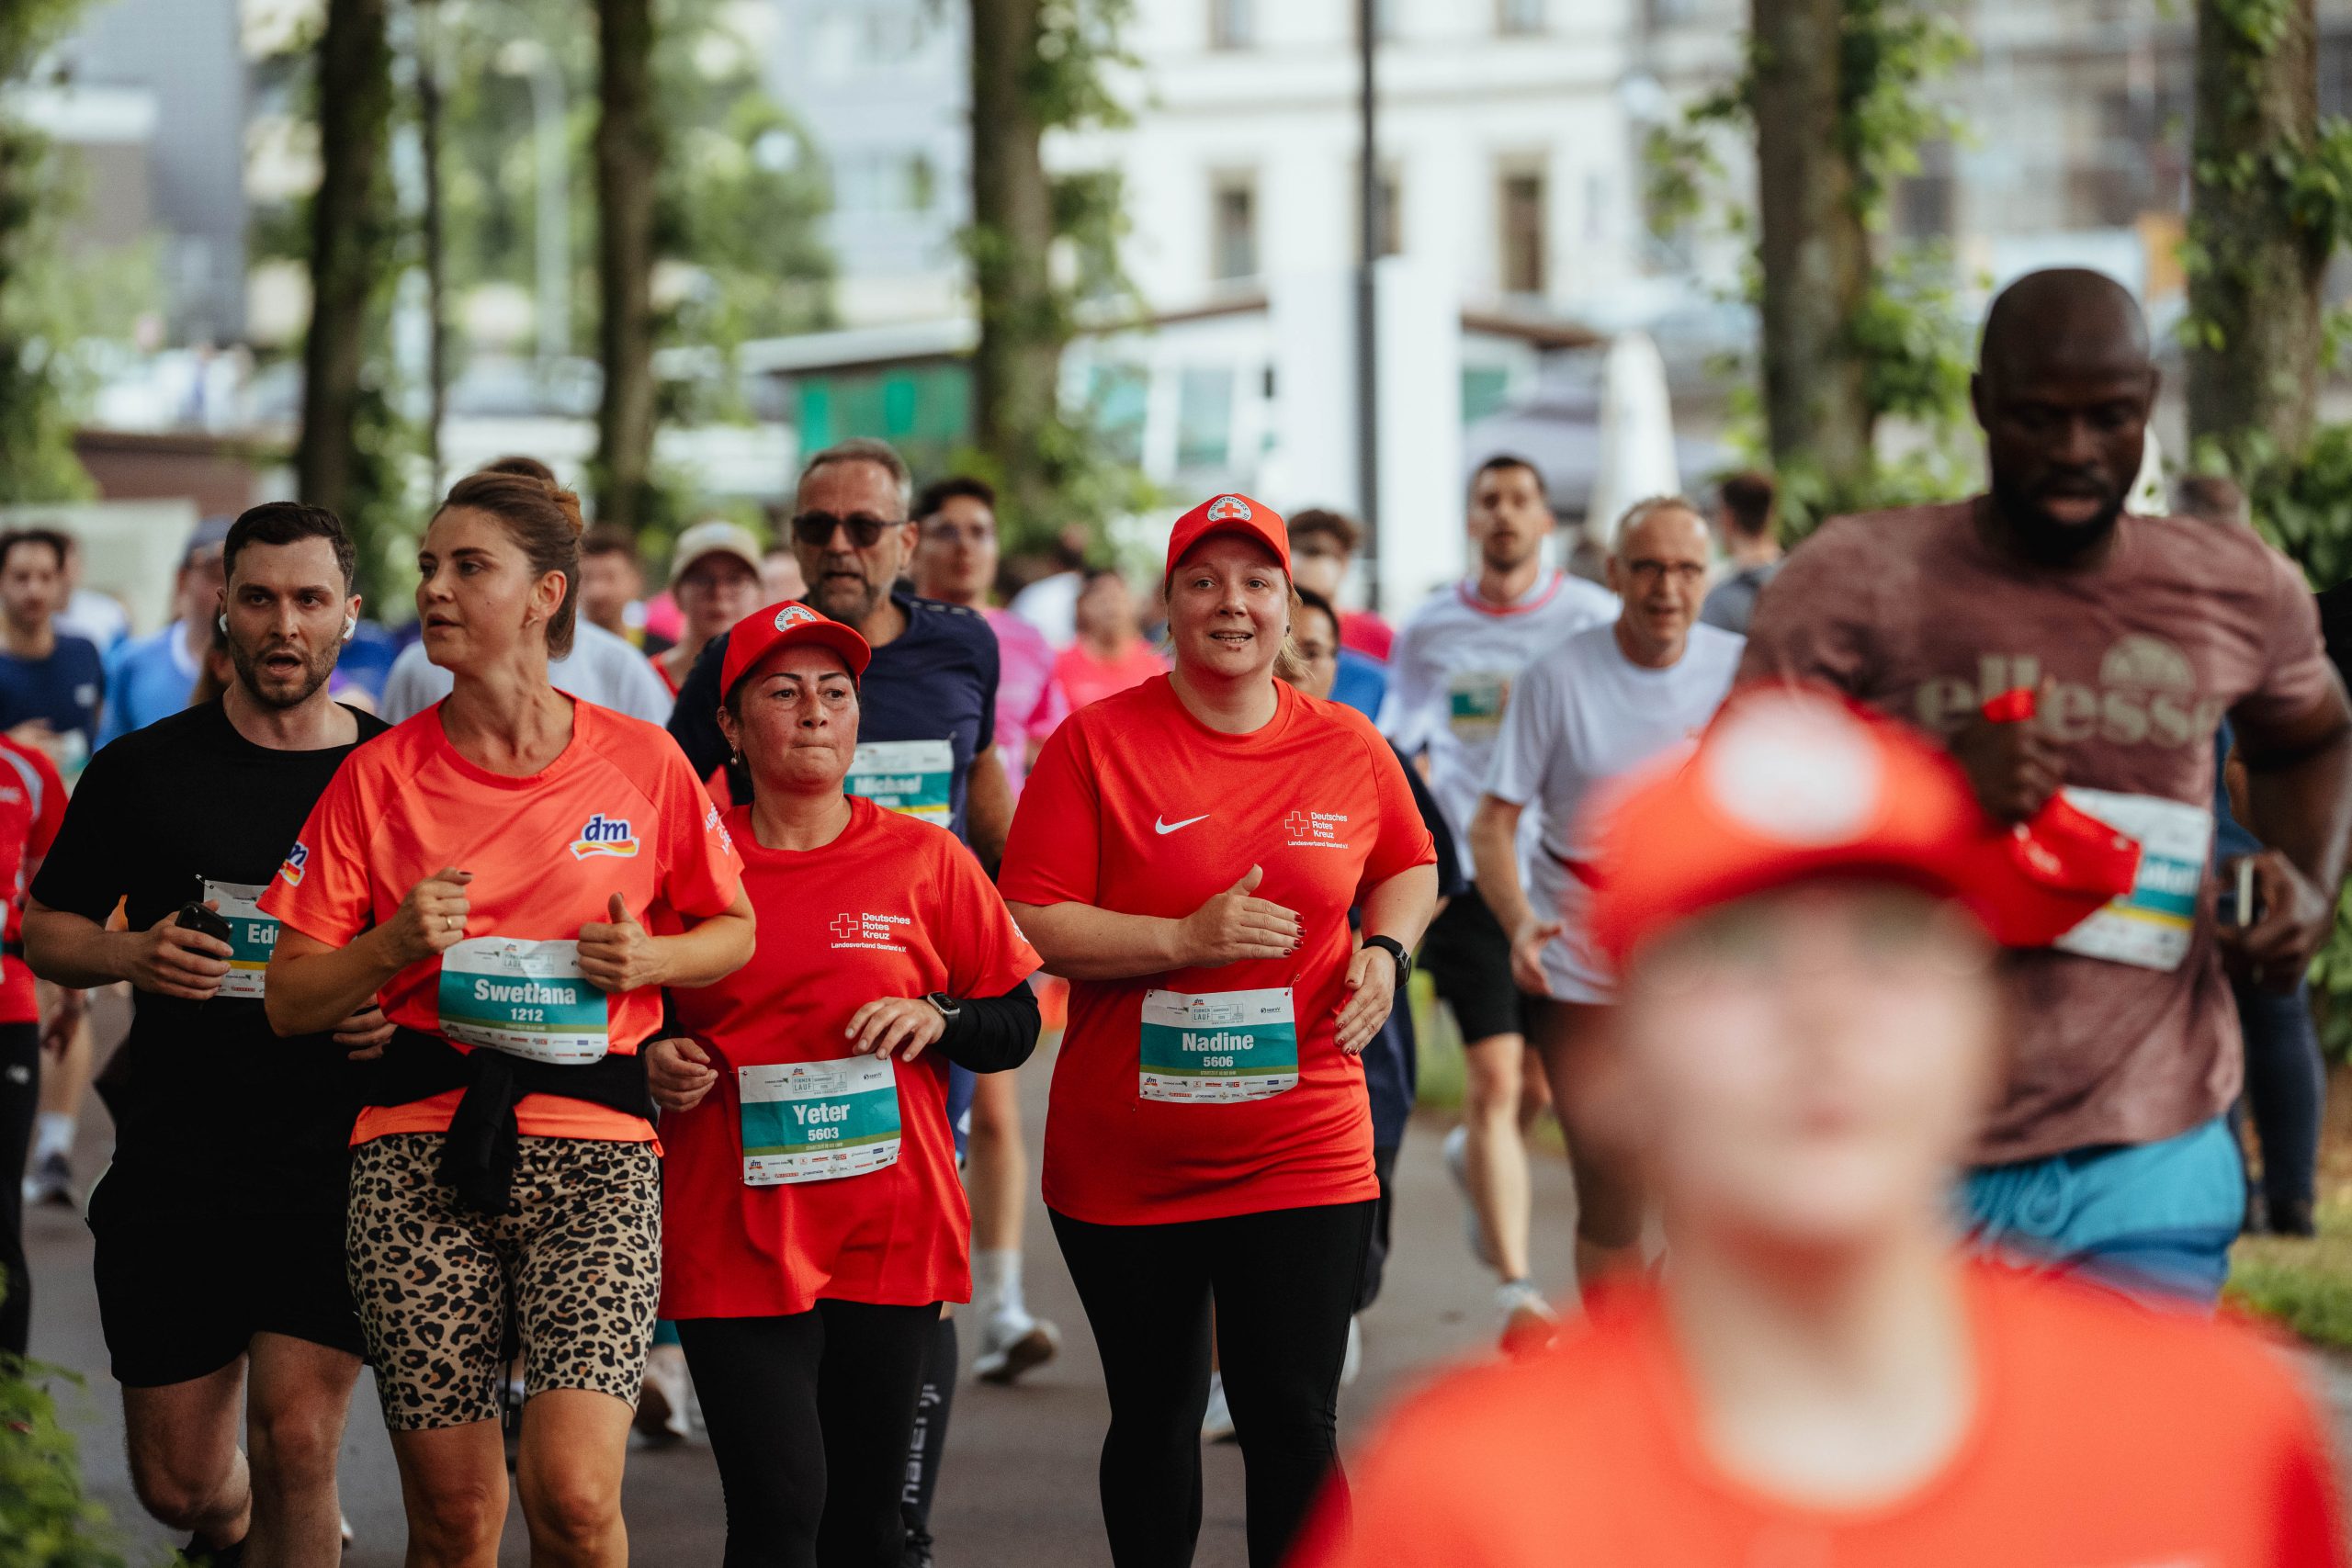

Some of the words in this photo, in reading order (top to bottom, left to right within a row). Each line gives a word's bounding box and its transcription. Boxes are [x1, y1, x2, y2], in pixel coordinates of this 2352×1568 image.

[1310, 811, 1348, 822] Deutsches
[584, 817, 628, 841] dm
[1312, 820, 1333, 830] Rotes
[1313, 829, 1335, 839] Kreuz
[862, 912, 911, 925] Deutsches
[862, 921, 890, 931] Rotes
[247, 923, 278, 944] Ed
[862, 931, 890, 941] Kreuz
[474, 978, 577, 1005] Swetlana
[510, 1008, 544, 1022] 1212
[1182, 1032, 1254, 1052] Nadine
[1203, 1055, 1234, 1067] 5606
[794, 1083, 812, 1091] LAUF
[793, 1102, 851, 1125] Yeter
[808, 1127, 840, 1142] 5603
